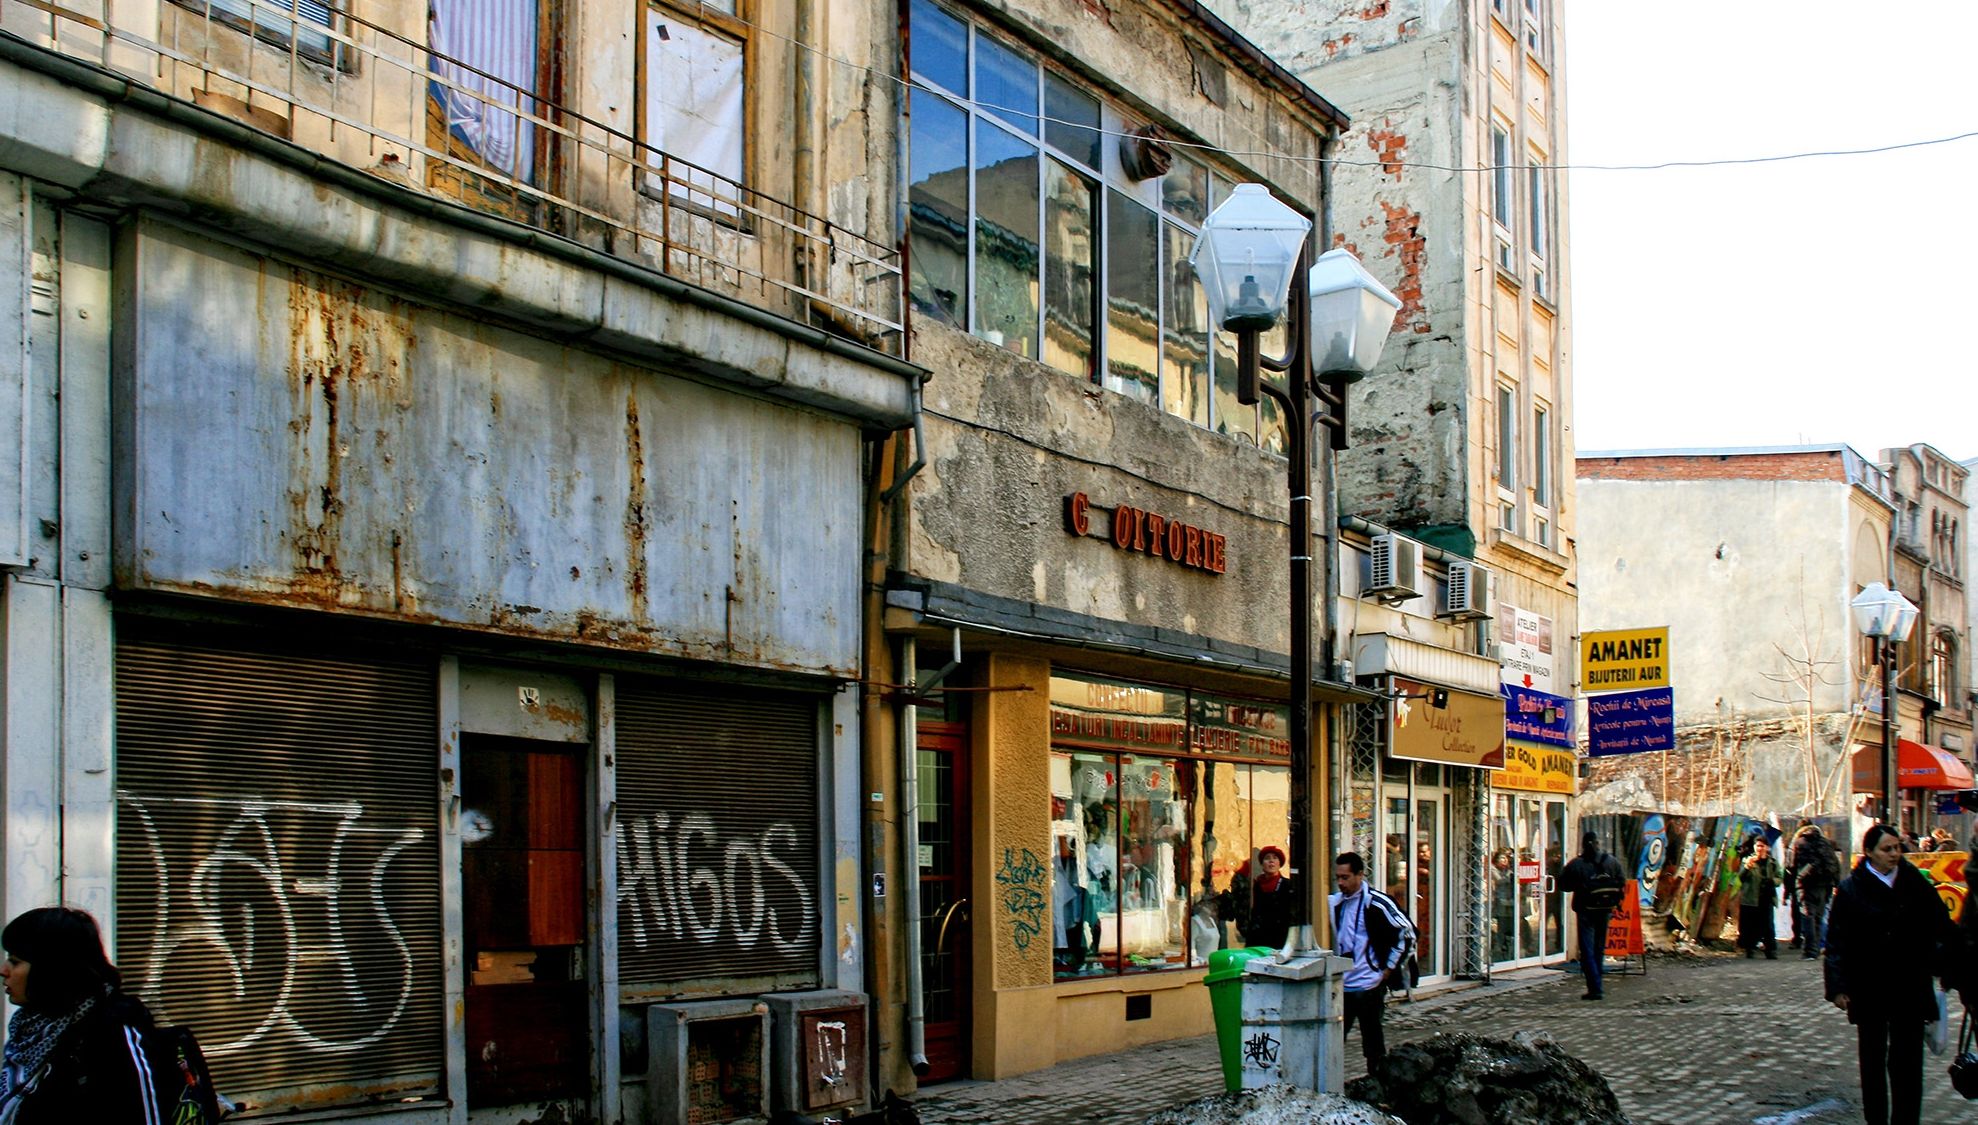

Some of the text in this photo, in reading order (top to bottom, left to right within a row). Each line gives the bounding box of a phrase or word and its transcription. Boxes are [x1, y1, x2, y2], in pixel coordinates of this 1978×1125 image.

[1517, 617, 1538, 632] ATELIER
[1588, 637, 1662, 662] AMANET
[1588, 666, 1662, 684] BIJUTERII AUR
[1622, 699, 1632, 711] de
[1190, 724, 1241, 753] LENJERIE
[1518, 748, 1537, 770] GOLD
